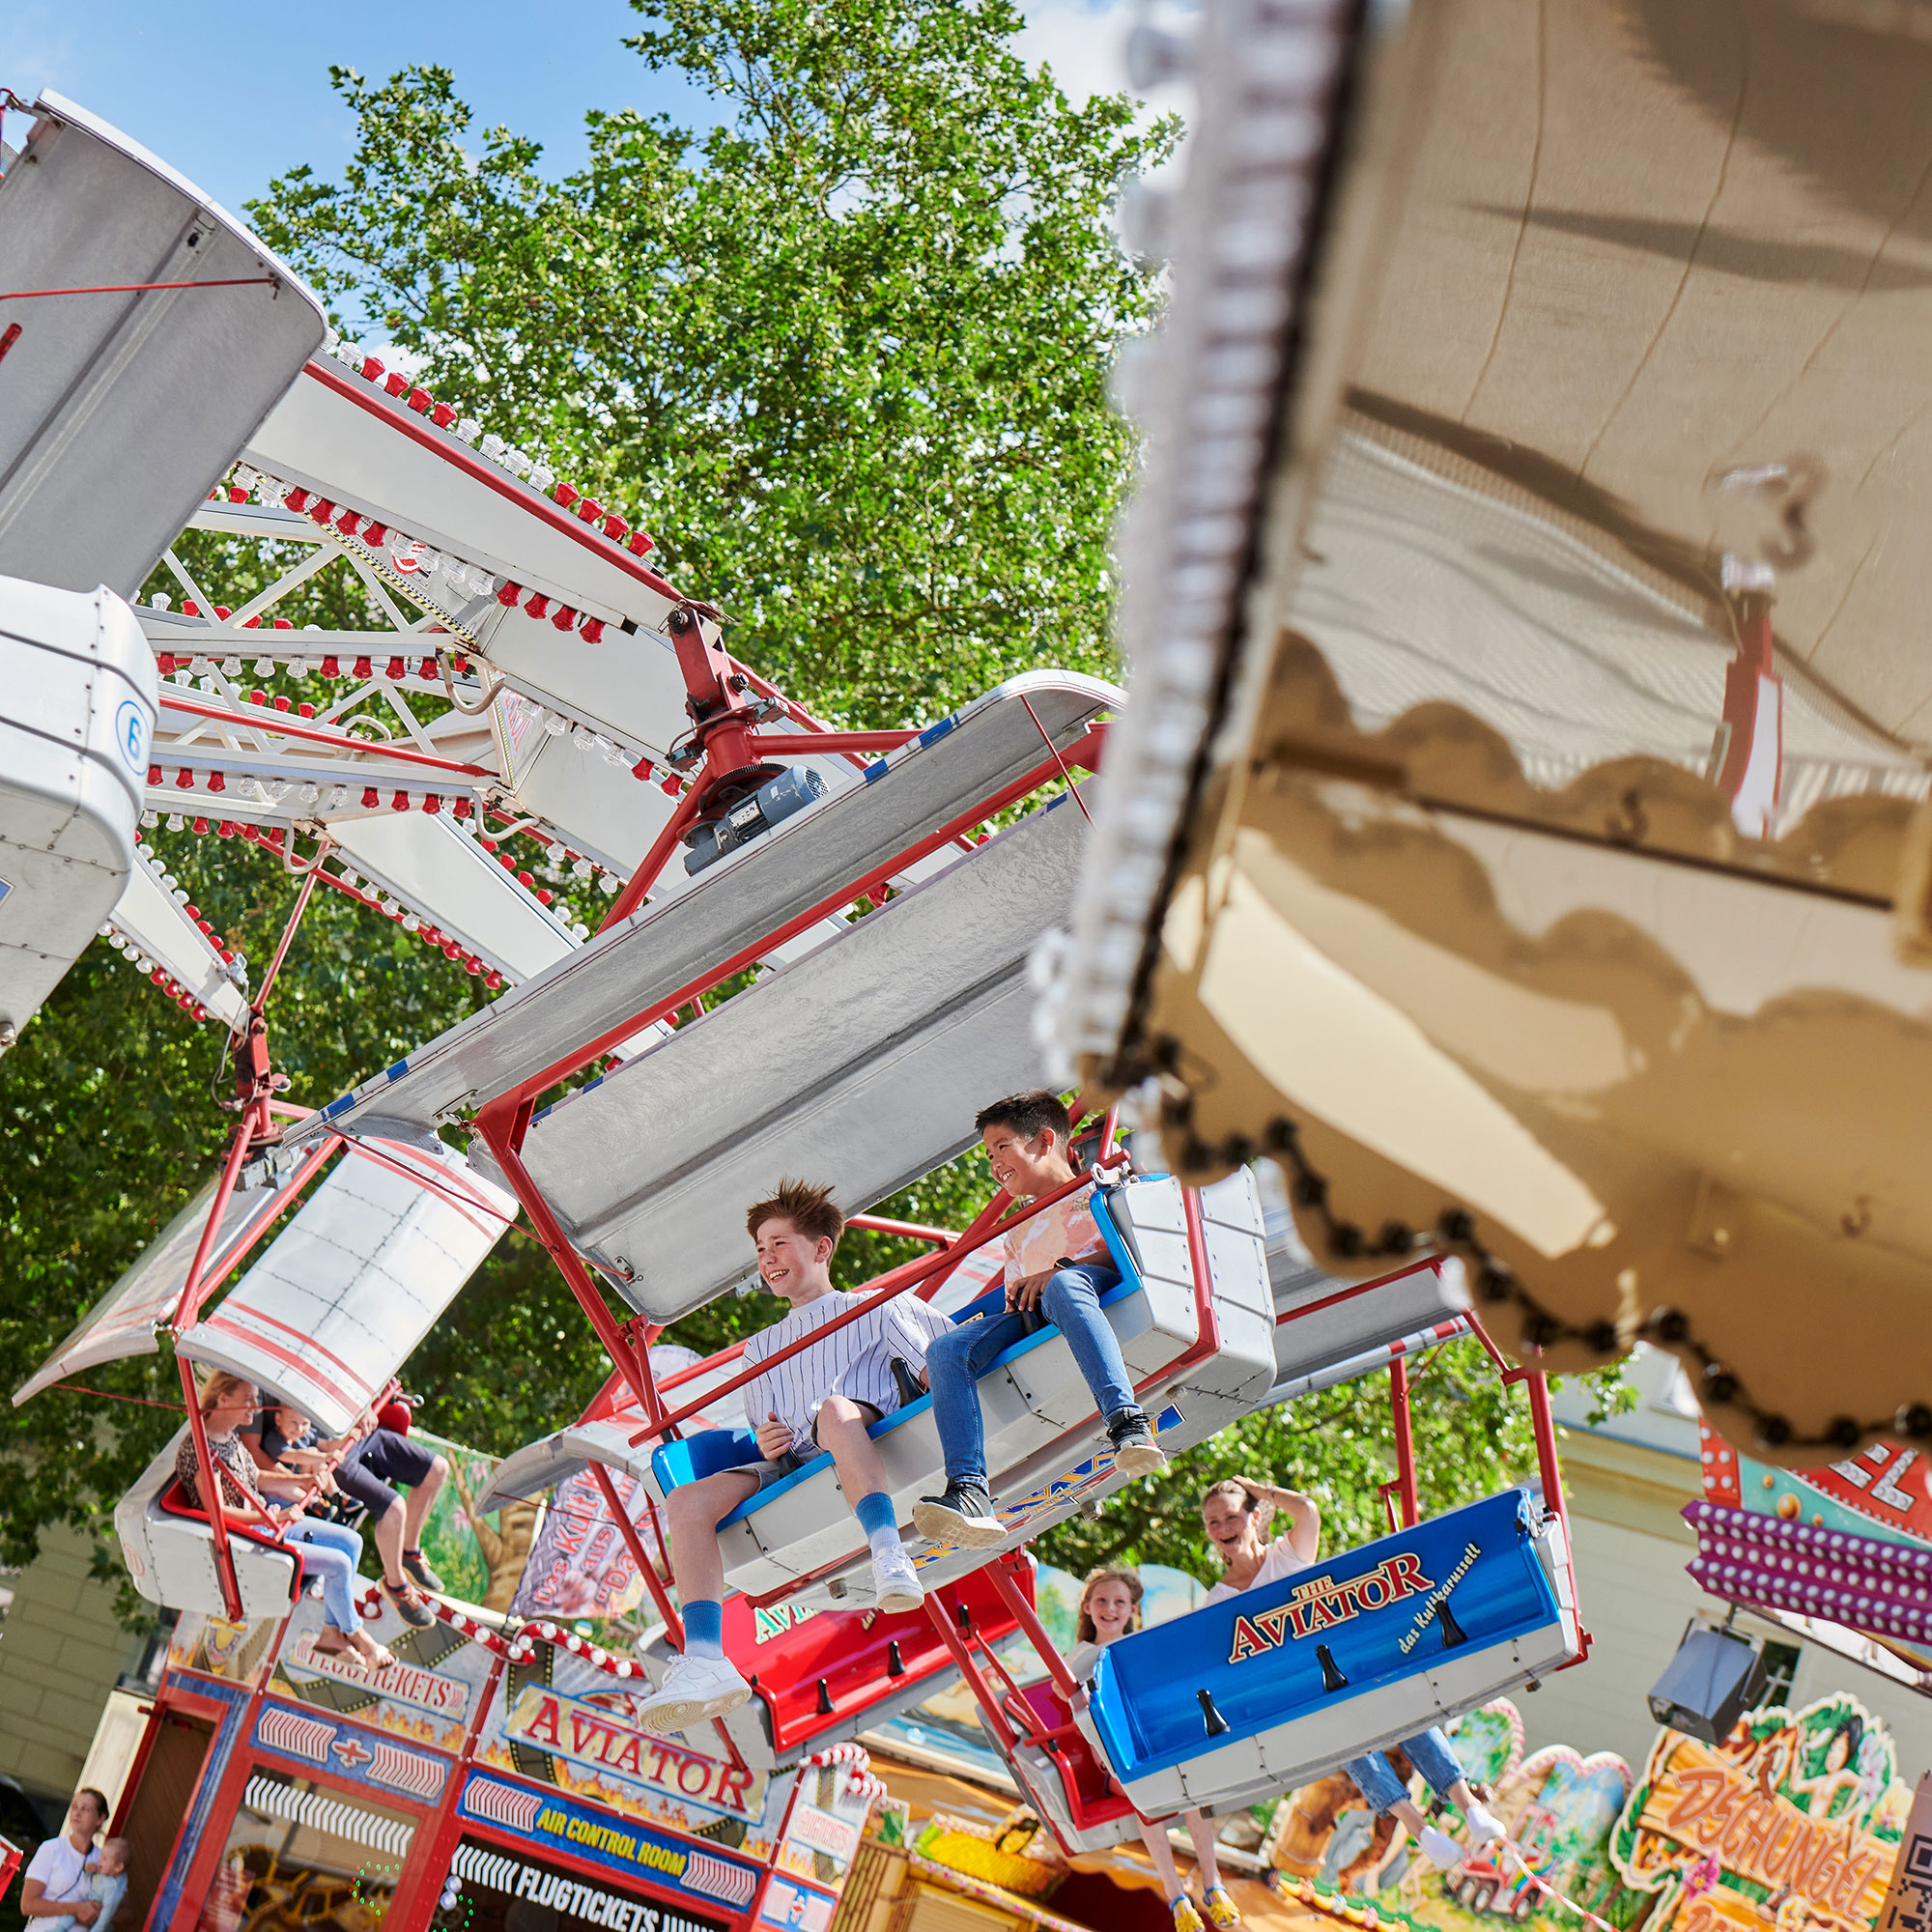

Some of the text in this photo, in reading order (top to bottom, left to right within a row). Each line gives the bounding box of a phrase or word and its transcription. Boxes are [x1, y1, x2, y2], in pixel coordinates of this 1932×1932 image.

[128, 716, 142, 761] 6
[533, 1494, 599, 1604] Das Kult
[582, 1527, 613, 1572] aus
[597, 1551, 639, 1601] "Da
[1229, 1552, 1435, 1663] AVIATOR
[1292, 1575, 1334, 1601] THE
[1398, 1628, 1421, 1654] das
[522, 1694, 754, 1813] AVIATOR
[536, 1807, 687, 1877] AIR CONTROL ROOM
[1665, 1767, 1883, 1919] DSCHUNGEL
[514, 1865, 661, 1932] FLUGTICKETS
